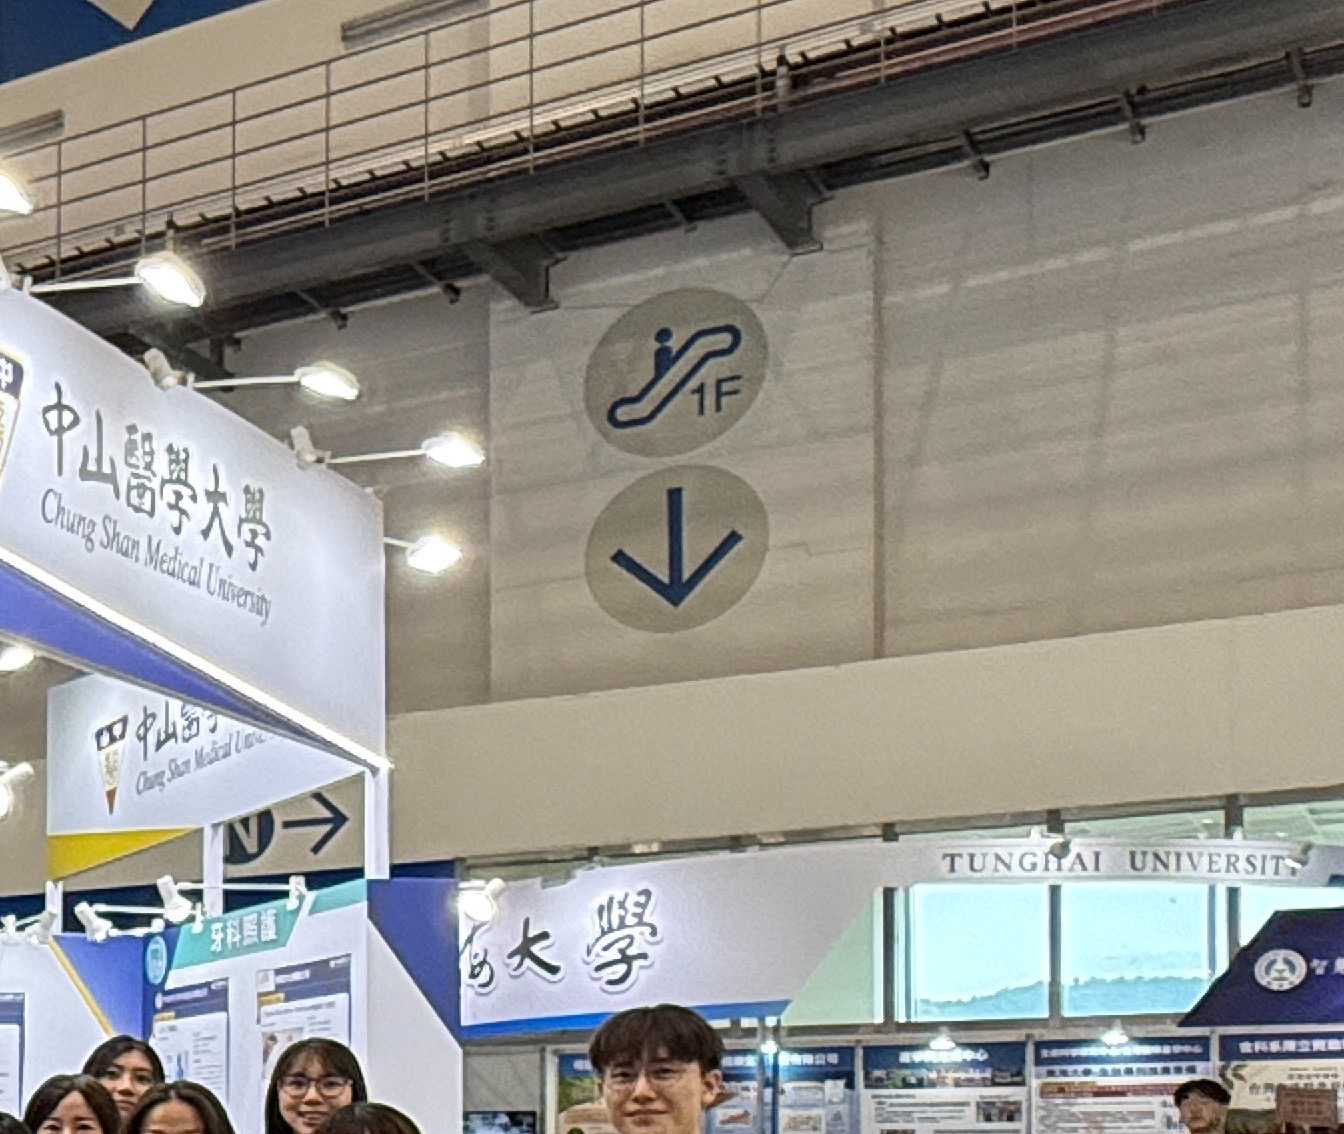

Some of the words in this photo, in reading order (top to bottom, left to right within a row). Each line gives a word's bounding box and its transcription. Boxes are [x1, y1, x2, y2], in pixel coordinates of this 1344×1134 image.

[690, 374, 742, 416] 1F
[42, 382, 272, 571] 中山醫學大學
[41, 488, 95, 551] Chung
[100, 524, 140, 564] Shan
[146, 540, 202, 590] Medical
[207, 563, 272, 626] University
